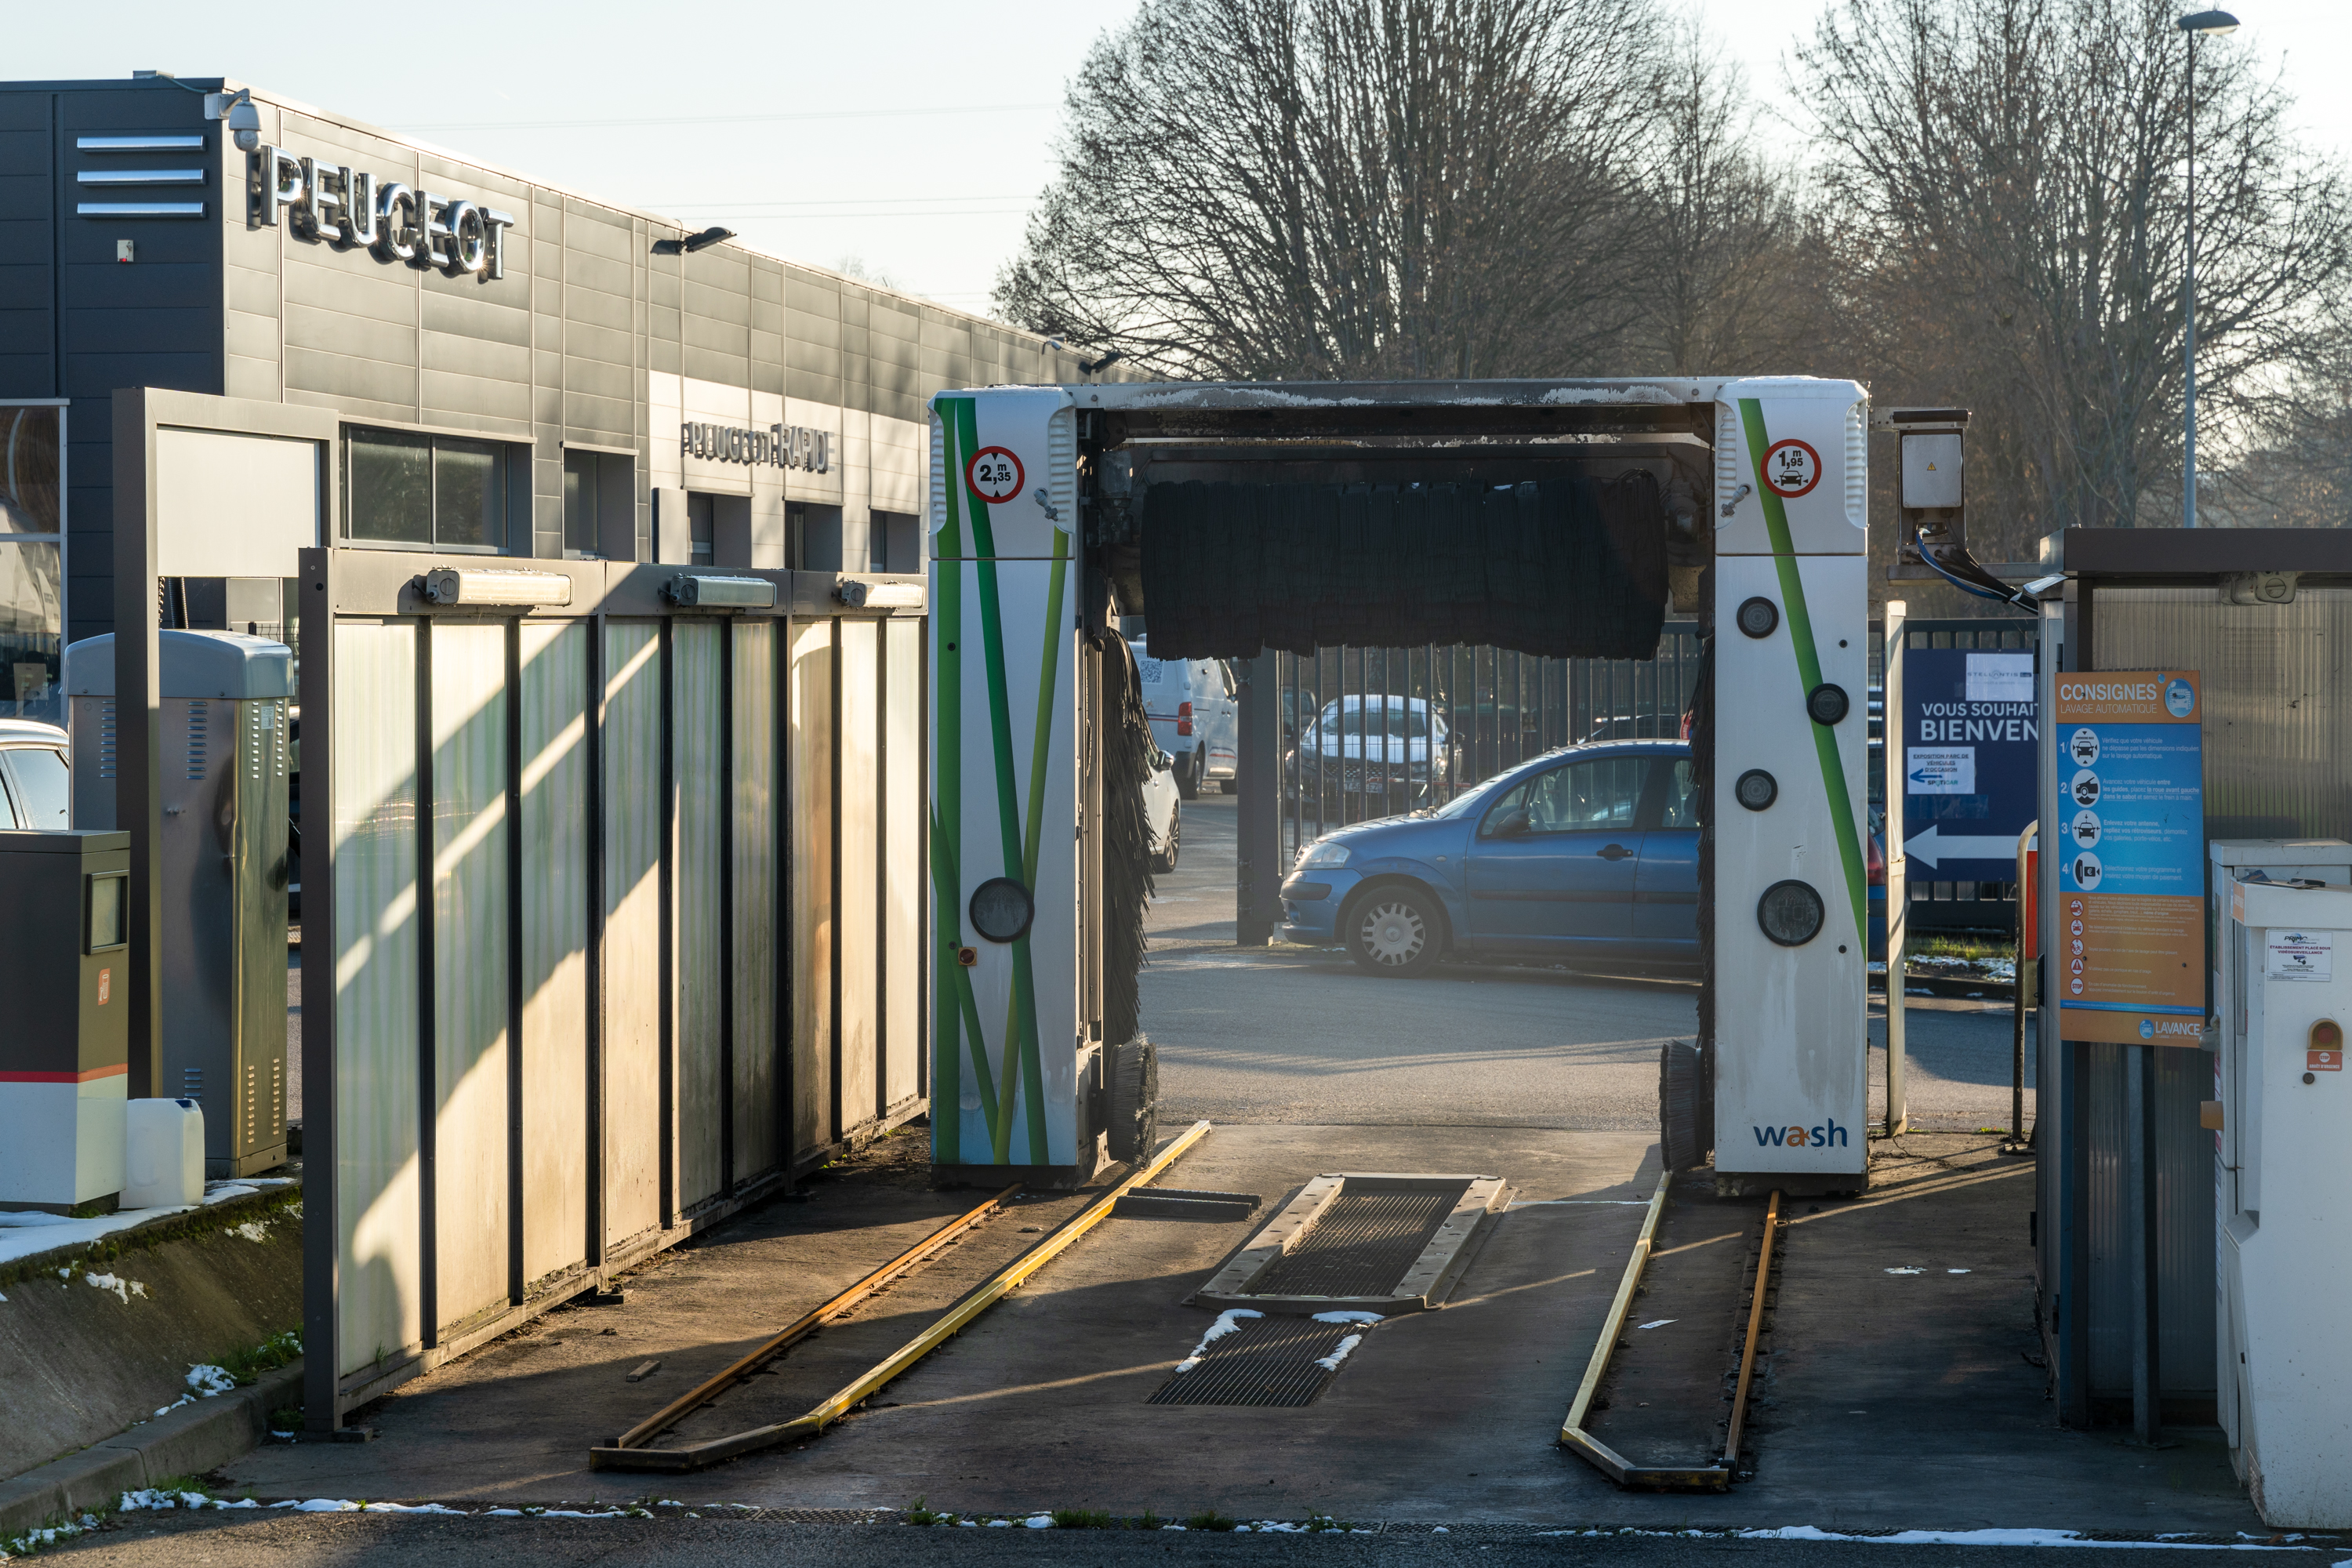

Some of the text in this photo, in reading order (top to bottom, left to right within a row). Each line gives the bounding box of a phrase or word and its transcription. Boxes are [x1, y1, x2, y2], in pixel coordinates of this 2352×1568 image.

[260, 145, 515, 280] PEUGEOT
[688, 421, 836, 472] PEUGEOT RAPIDE
[2060, 683, 2157, 701] CONSIGNES
[1922, 702, 1968, 717] VOUS
[2060, 704, 2157, 714] LAVAGE AUTOMATIQUE
[2156, 1021, 2200, 1036] LAVANCE
[1753, 1118, 1847, 1147] wash
